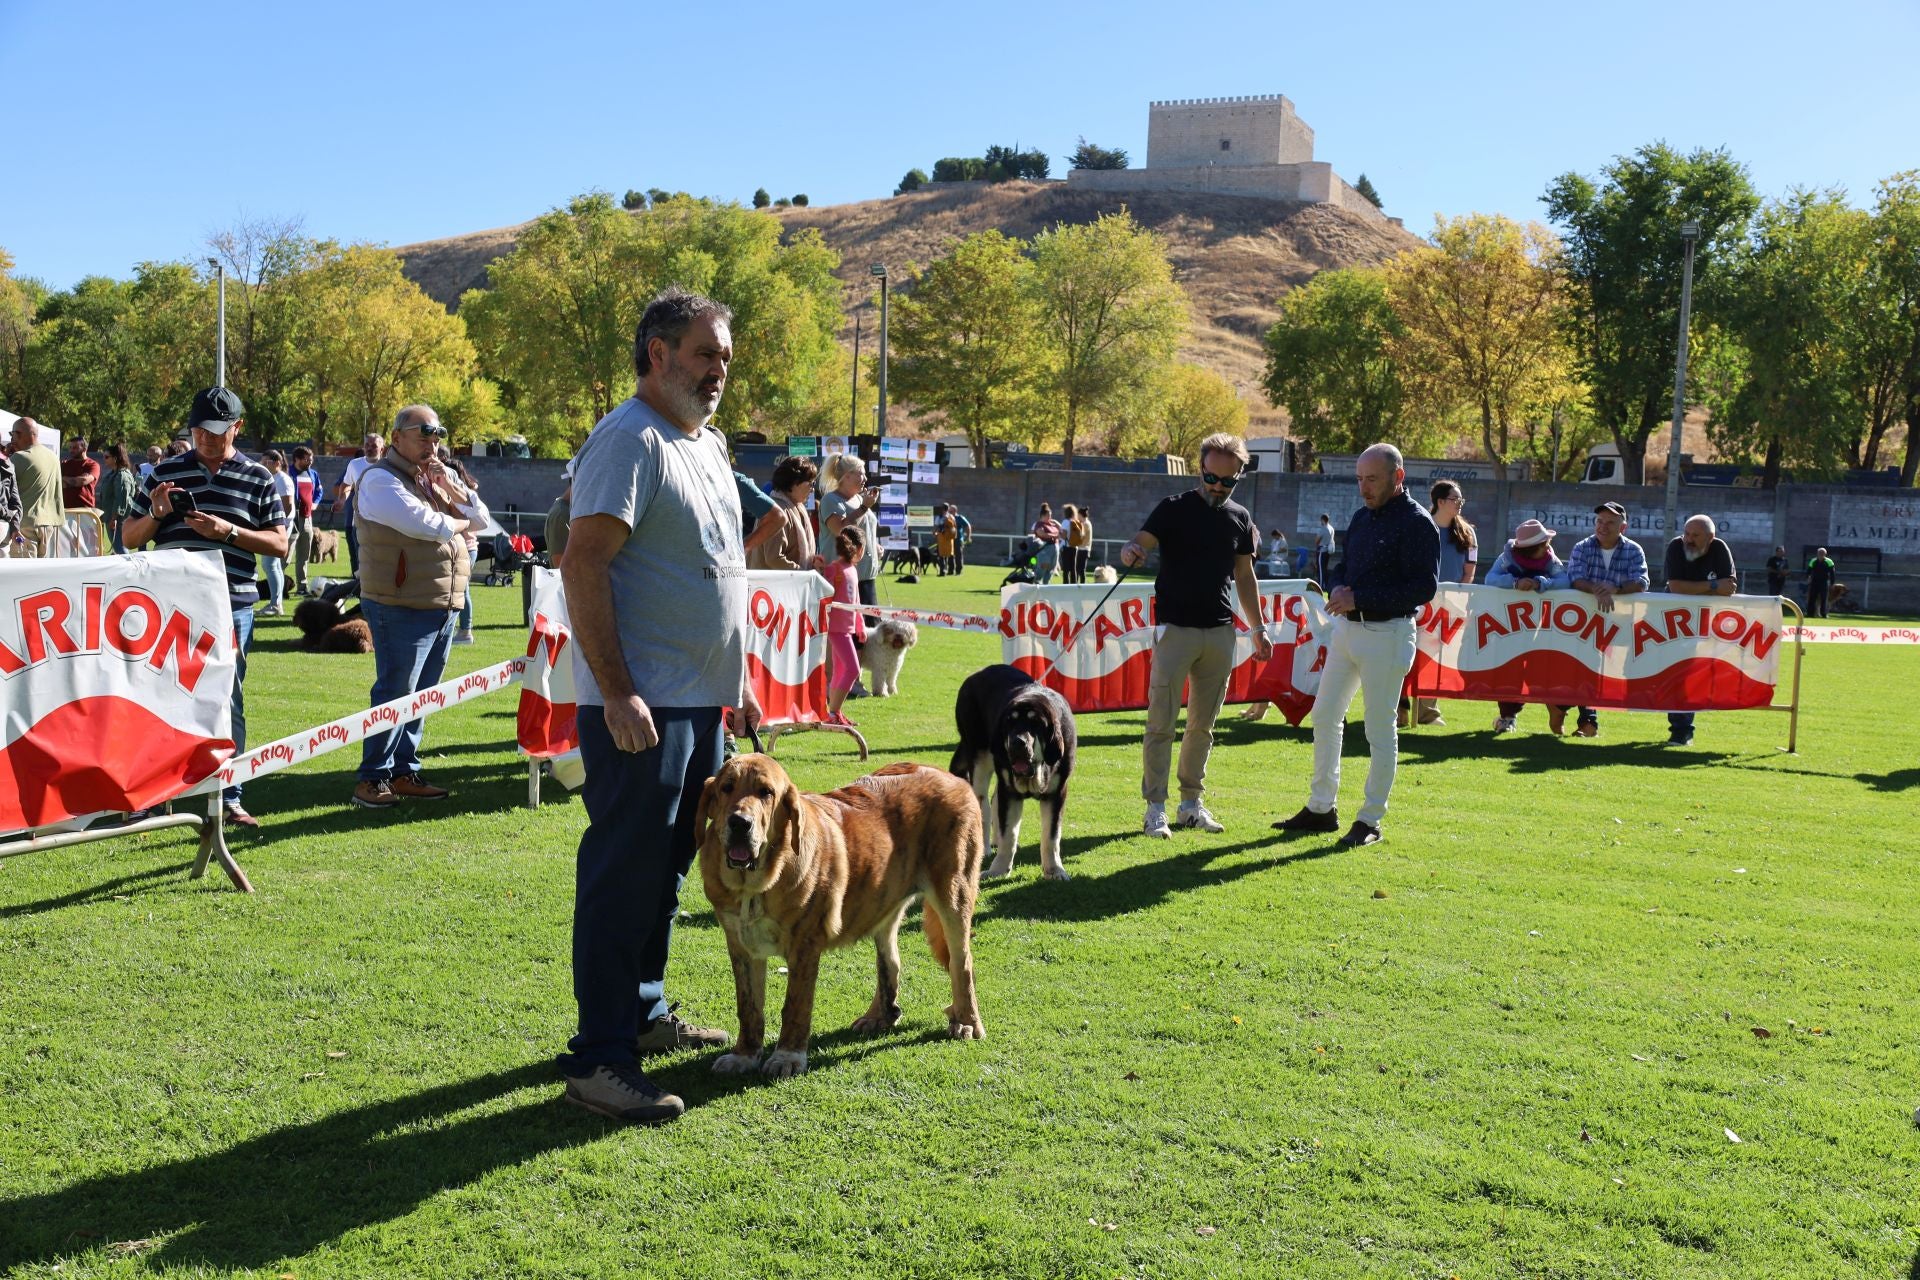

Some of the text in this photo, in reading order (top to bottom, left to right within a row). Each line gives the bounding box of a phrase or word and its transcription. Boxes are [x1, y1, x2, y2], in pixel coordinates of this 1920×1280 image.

[1835, 525, 1858, 538] LA
[702, 567, 719, 580] THE
[928, 612, 954, 628] ARION
[963, 615, 989, 630] ARION
[1476, 600, 1620, 654] ARION
[1633, 606, 1780, 661] ARION
[1829, 628, 1868, 642] ARION
[1881, 629, 1920, 643] ARION
[250, 744, 295, 776] ARION
[307, 725, 349, 756] ARION
[361, 706, 400, 736] ARION
[411, 690, 446, 717] ARION
[457, 675, 490, 702] ARION
